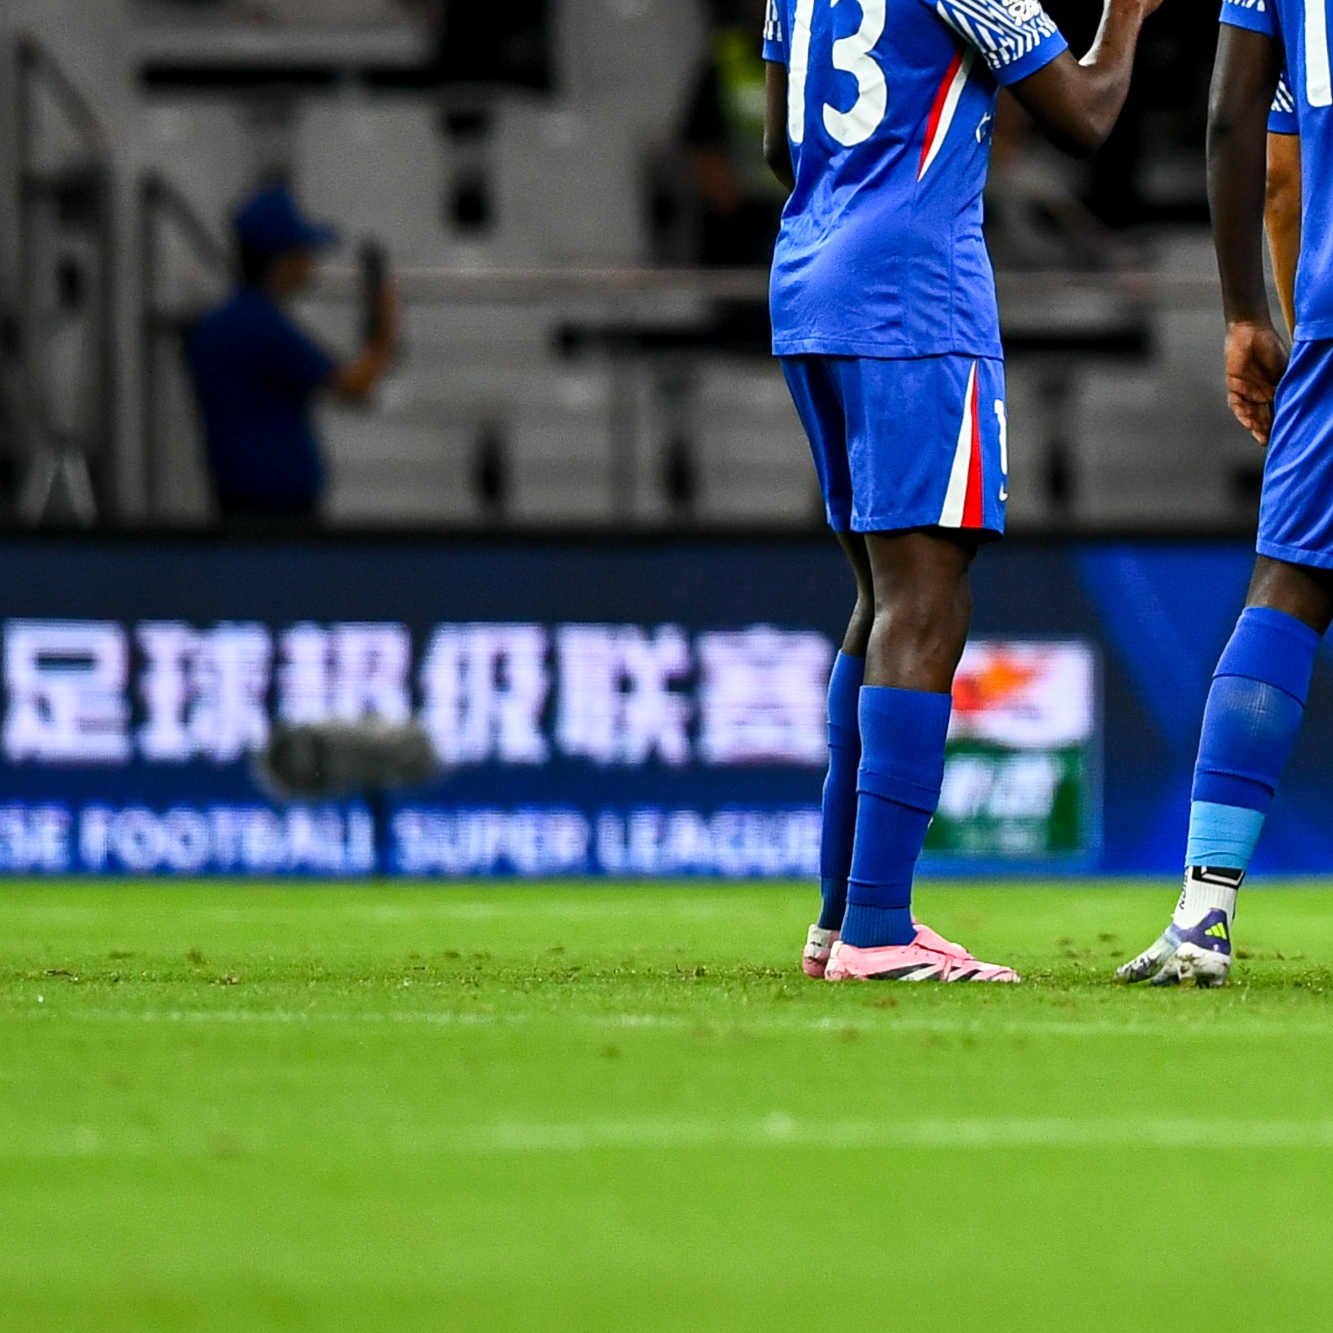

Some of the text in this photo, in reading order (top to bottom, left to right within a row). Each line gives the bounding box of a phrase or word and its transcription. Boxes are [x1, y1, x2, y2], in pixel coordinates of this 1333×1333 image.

[4, 618, 832, 769] 足球超级联赛
[79, 804, 377, 873] FOOTBALL
[395, 807, 588, 874] SUPER
